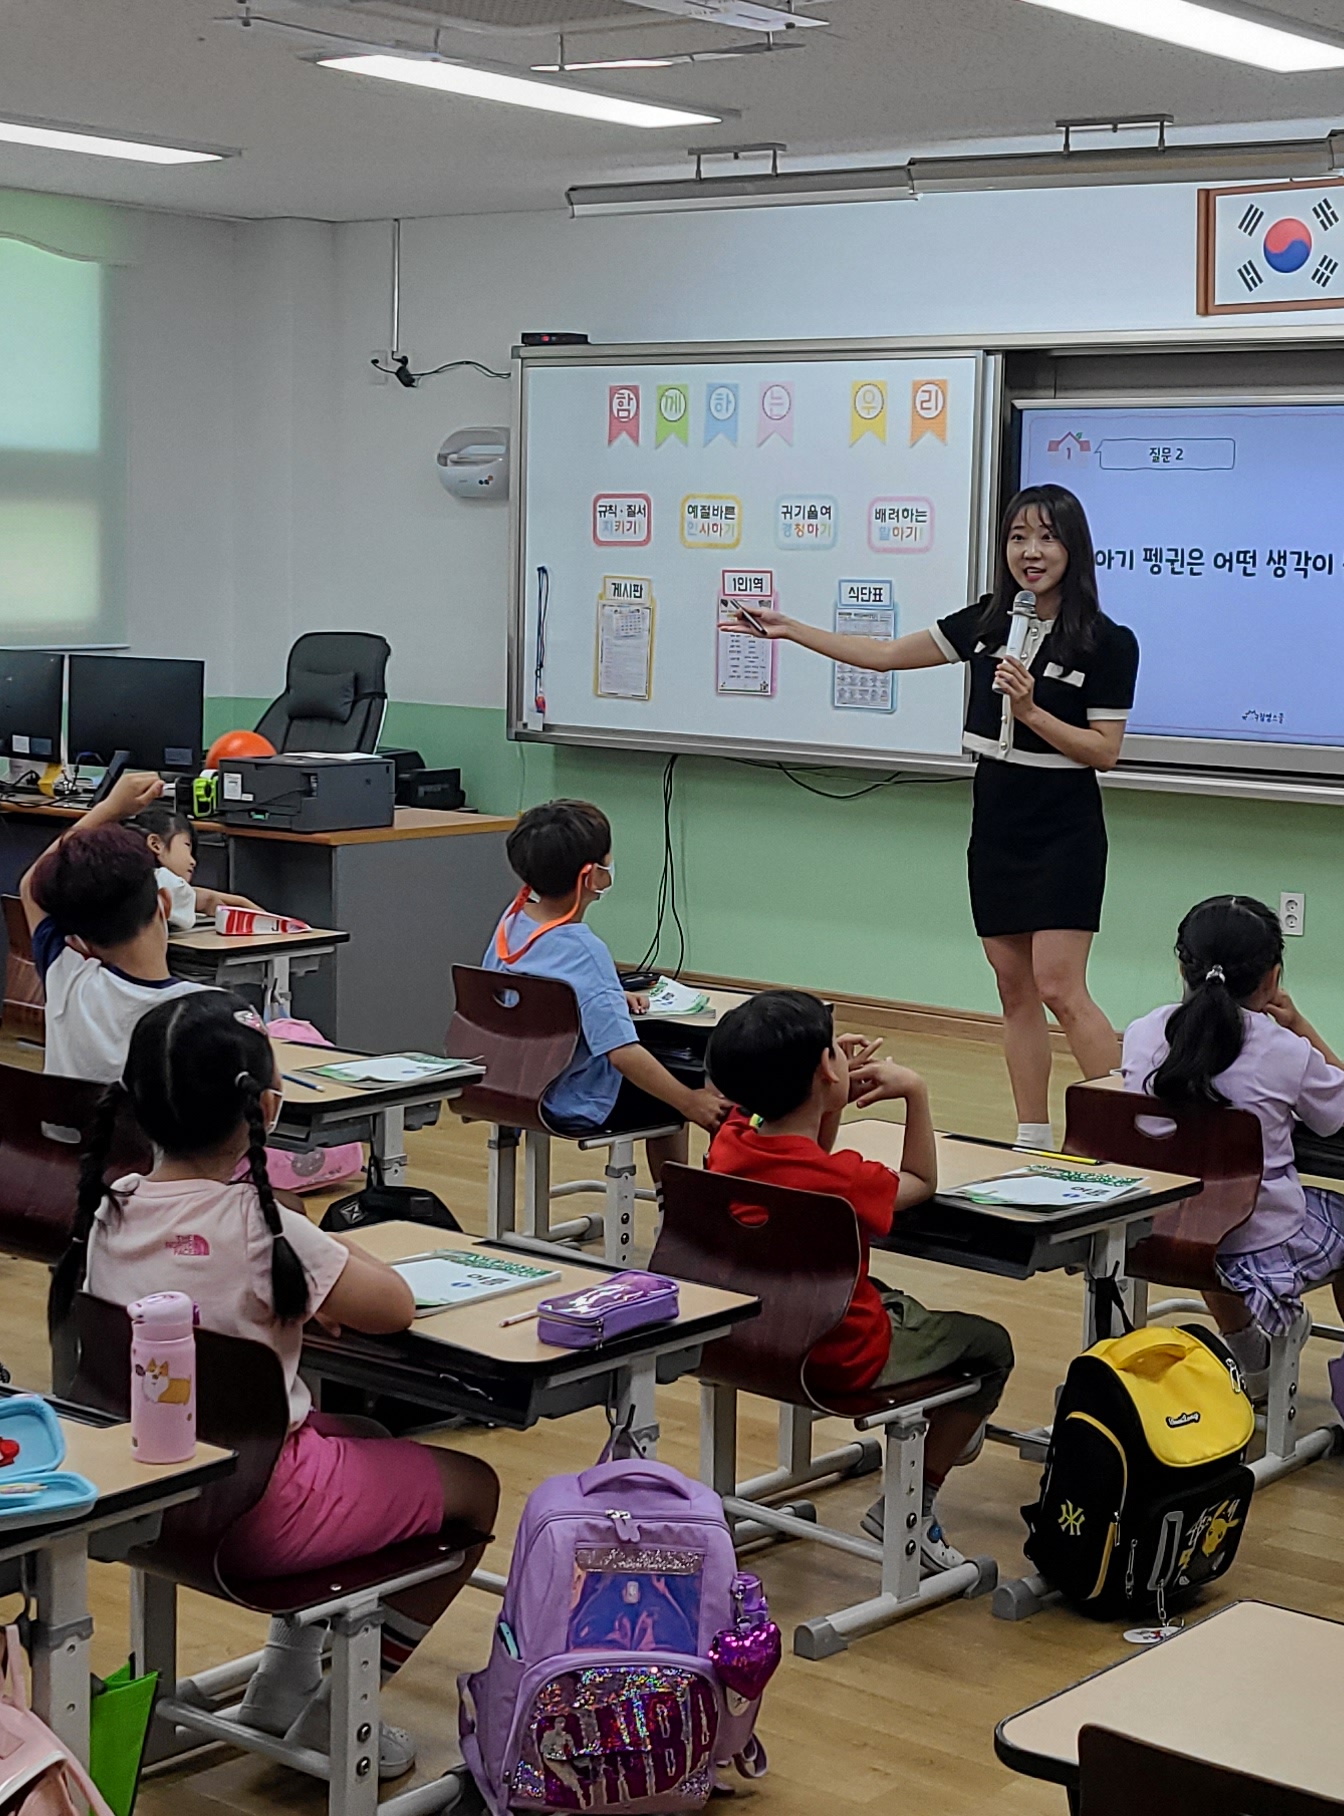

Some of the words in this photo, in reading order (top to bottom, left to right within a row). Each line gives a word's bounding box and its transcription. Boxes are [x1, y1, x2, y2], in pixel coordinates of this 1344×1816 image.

[1149, 446, 1172, 463] 질문
[1175, 448, 1184, 461] 2
[687, 504, 736, 520] 예절바른
[781, 504, 832, 521] 귀기울여
[874, 507, 928, 523] 배려하는
[1095, 549, 1134, 571] 아기
[1142, 547, 1205, 577] 펭귄은
[1213, 549, 1257, 578] 어떤
[1266, 549, 1334, 580] 생각이
[611, 582, 644, 599] 게시판
[733, 576, 764, 593] 1인1역
[848, 586, 884, 603] 식단표
